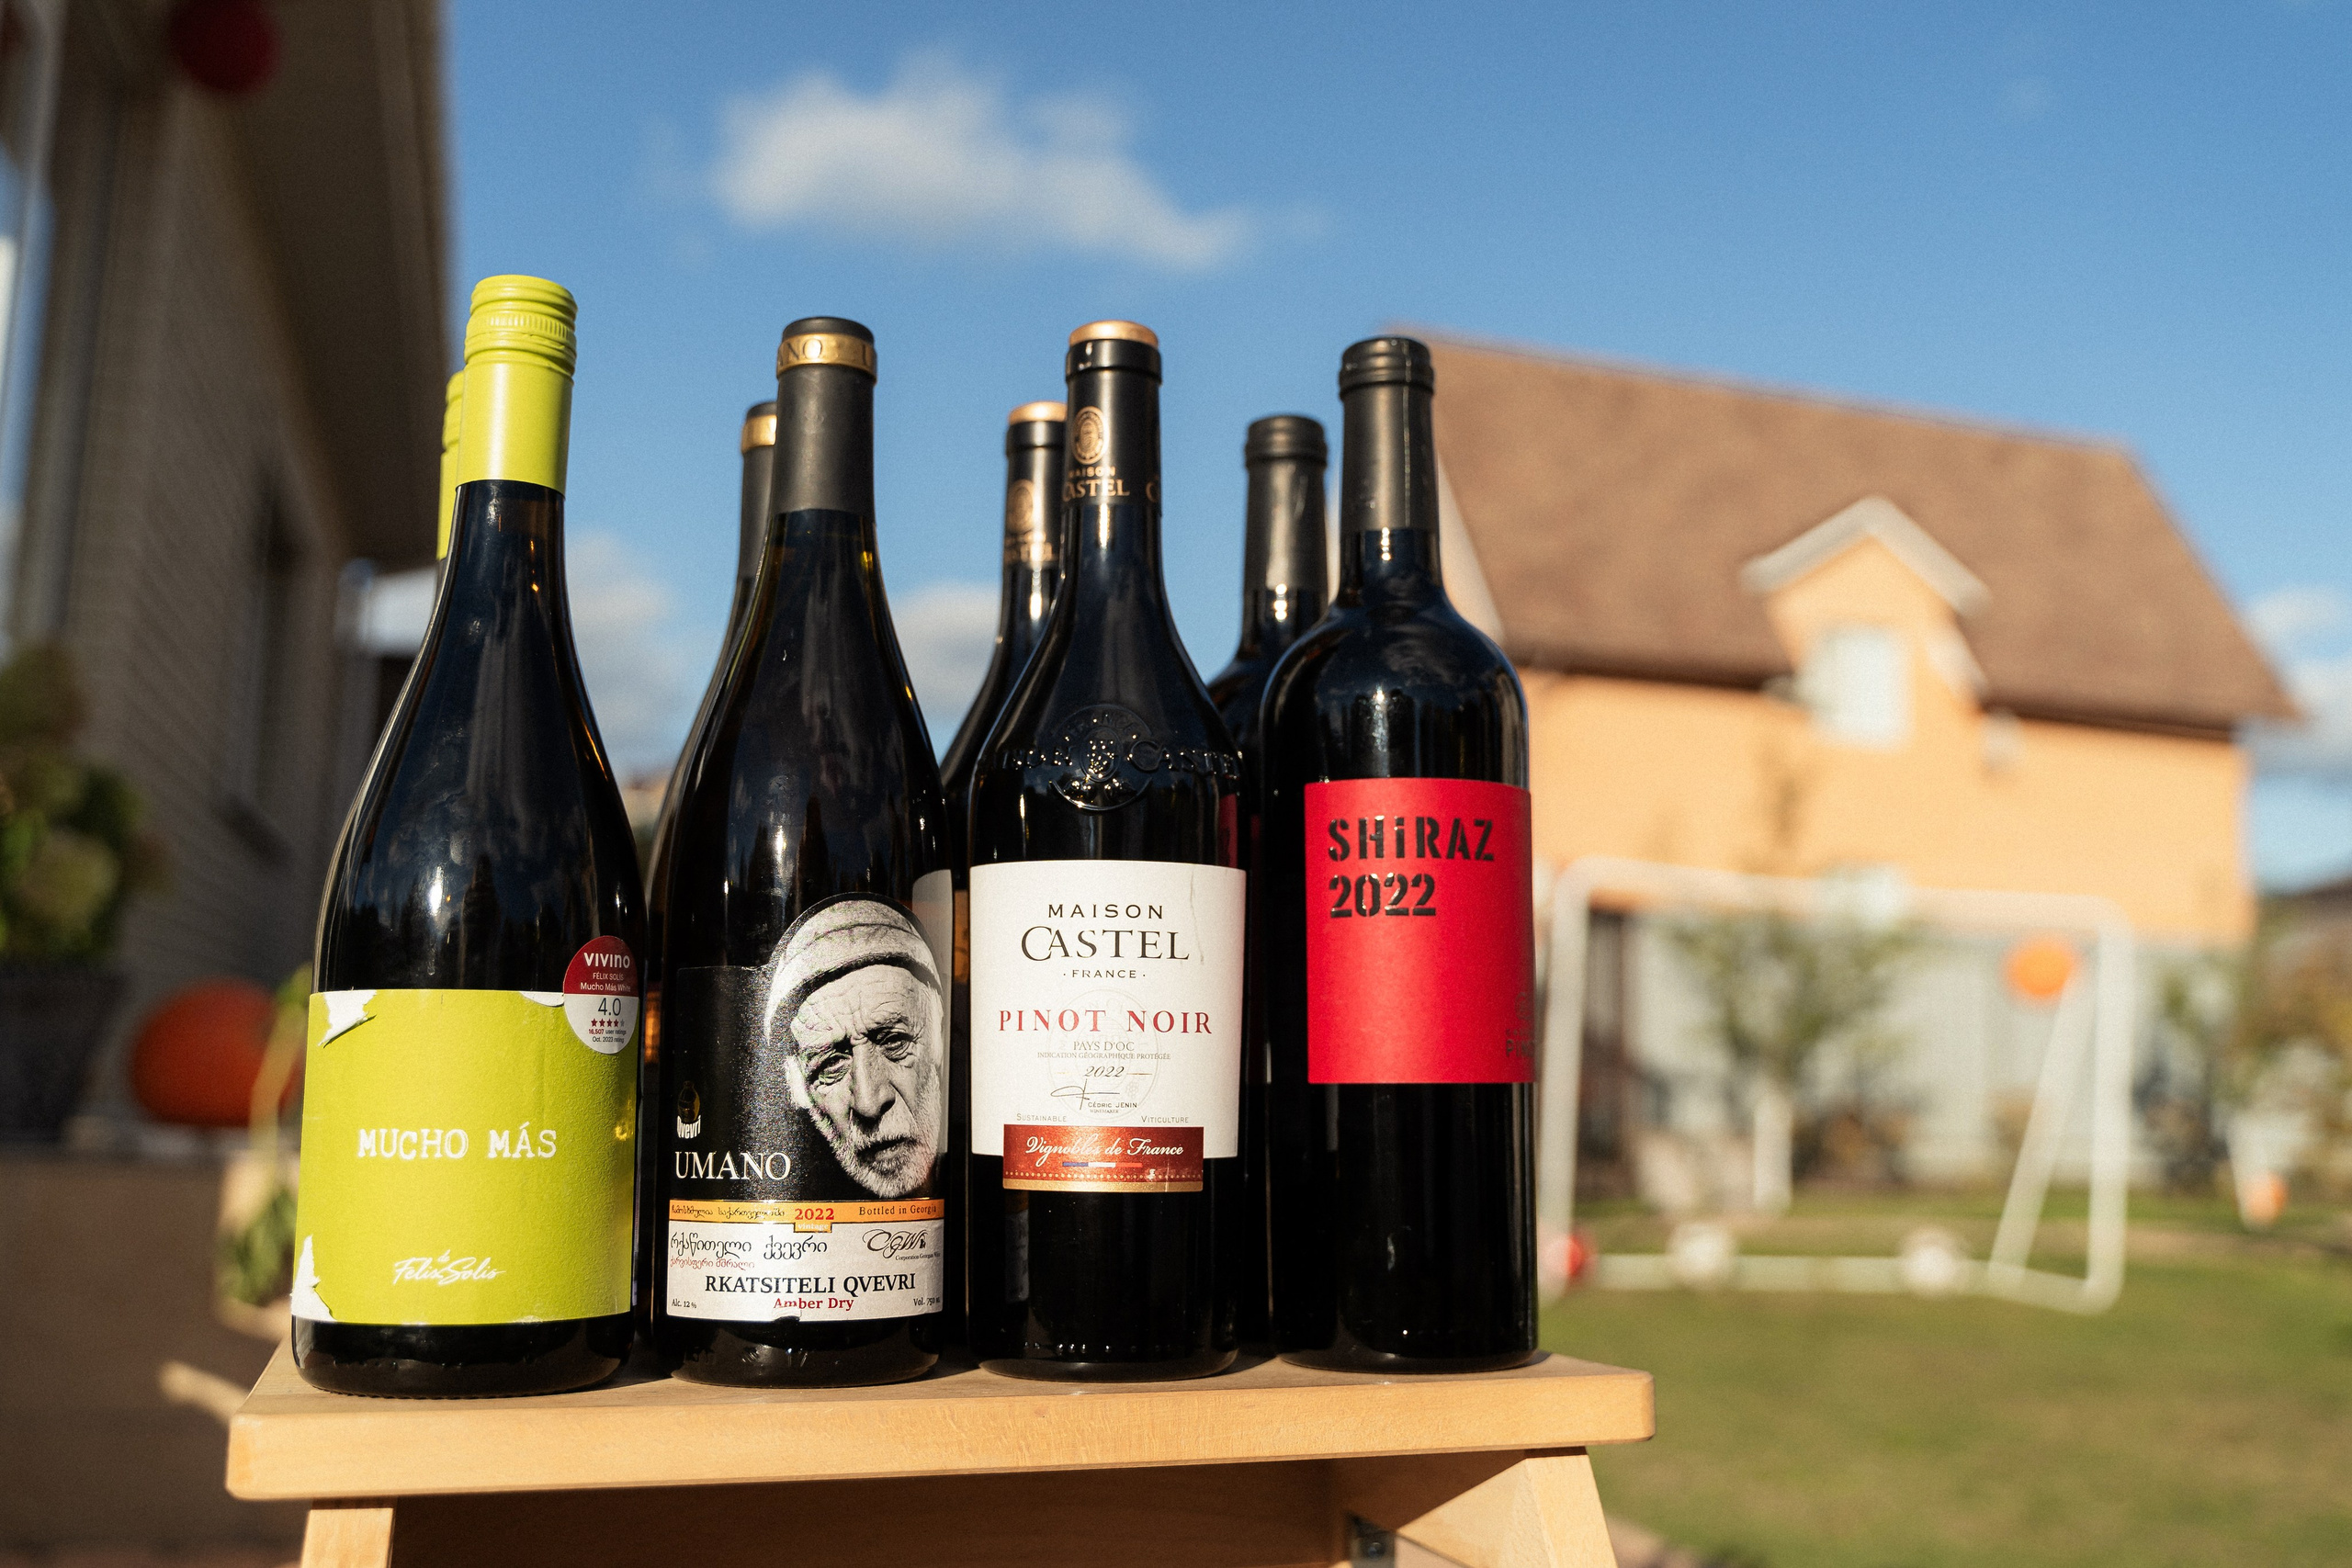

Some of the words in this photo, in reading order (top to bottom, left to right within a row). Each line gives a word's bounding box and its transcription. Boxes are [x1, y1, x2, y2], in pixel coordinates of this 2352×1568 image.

[1329, 872, 1436, 918] 2022
[1047, 904, 1163, 919] MAISON
[1021, 925, 1190, 962] CASTEL
[593, 972, 608, 980] FÉLIX
[1071, 969, 1137, 979] FRANCE
[580, 982, 604, 991] Mucho
[605, 983, 616, 992] Más
[597, 997, 622, 1016] 4.0
[999, 1009, 1106, 1032] PINOT
[1126, 1010, 1213, 1034] NOIR
[1073, 1041, 1101, 1051] PAYS
[1103, 1041, 1135, 1052] D'OC
[1078, 1051, 1136, 1060] GÉOGRAPHIQUE
[1136, 1052, 1171, 1060] PROTÉGÉE
[1084, 1066, 1125, 1077] 2022
[357, 1128, 469, 1160] MUCHO
[488, 1121, 557, 1159] MÁS
[1025, 1133, 1102, 1168] Vignobles
[1104, 1137, 1123, 1155] de
[1126, 1137, 1183, 1156] France
[674, 1150, 791, 1180] UMANO
[794, 1208, 835, 1221] 2022
[859, 1206, 895, 1216] Bottled
[899, 1206, 907, 1214] in
[910, 1204, 937, 1215] Georgia
[797, 1223, 829, 1232] vintage
[670, 1232, 752, 1258] რქაწითელი
[763, 1235, 828, 1260] ქვევრი
[705, 1275, 836, 1294] RKATSITELI
[843, 1273, 916, 1297] QVEVRI
[671, 1299, 682, 1307] Alc.
[773, 1297, 823, 1309] Amber
[828, 1297, 854, 1311] Dry
[912, 1296, 925, 1306] Vol.
